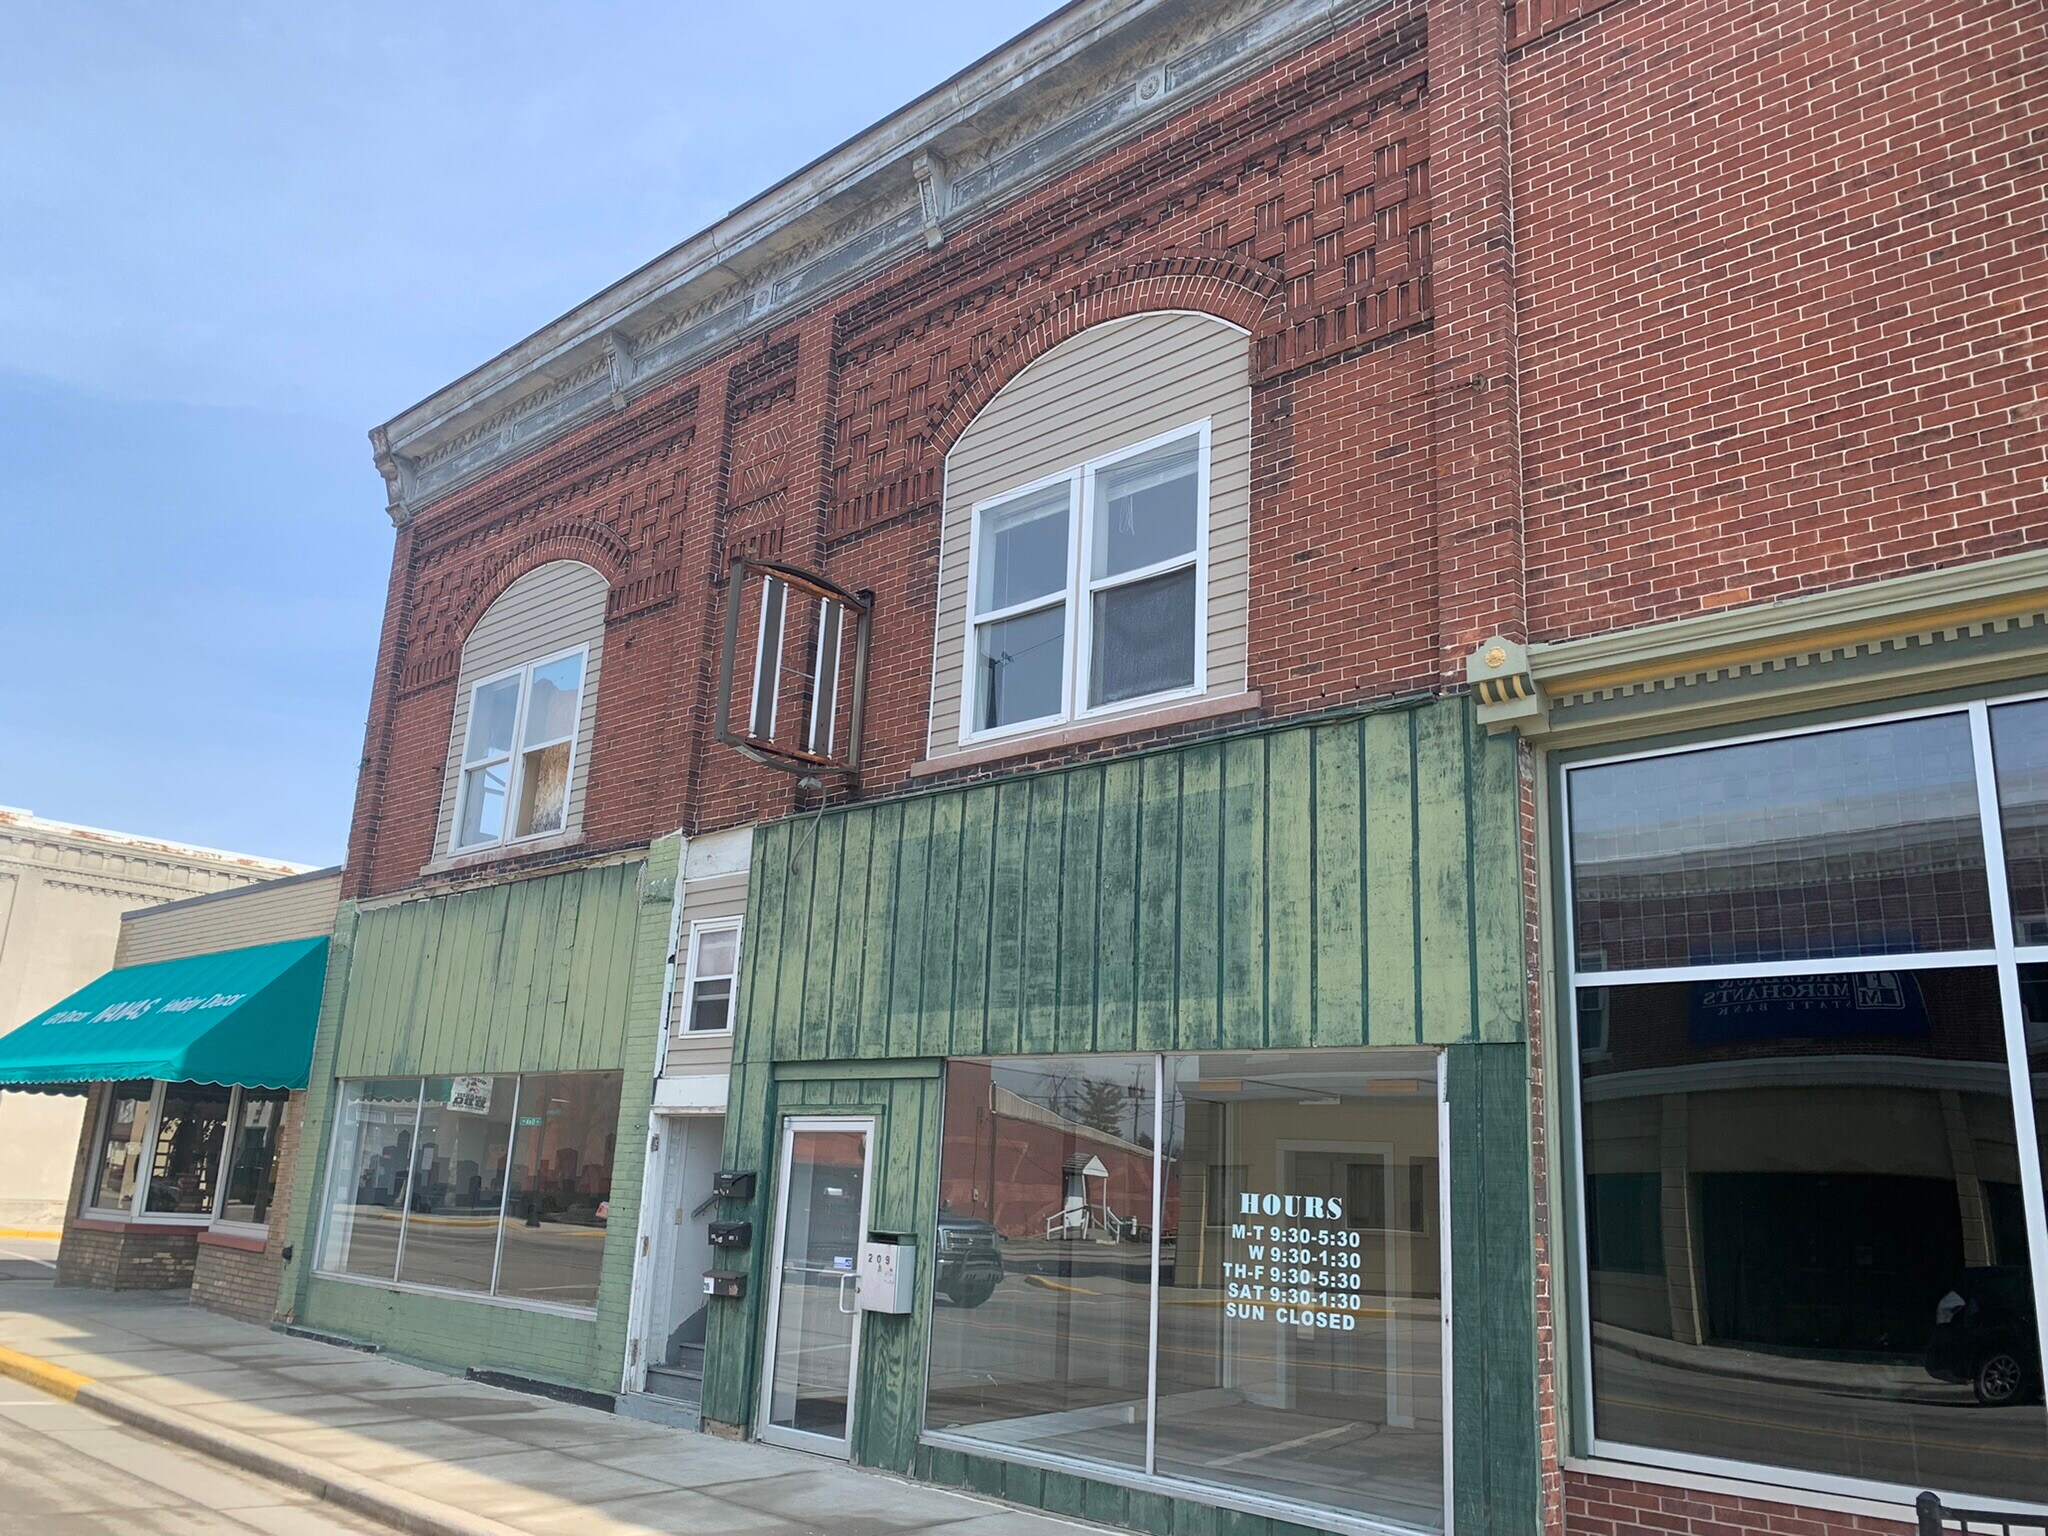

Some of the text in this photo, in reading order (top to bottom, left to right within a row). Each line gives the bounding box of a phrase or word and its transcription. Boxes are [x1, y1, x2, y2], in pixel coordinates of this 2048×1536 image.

[198, 993, 247, 1010] Decor
[1239, 1192, 1343, 1220] HOURS
[1232, 1224, 1361, 1248] M-T 9:30-5:30
[868, 1253, 891, 1265] 209
[1248, 1245, 1361, 1269] W 9:30-1:30
[1223, 1262, 1361, 1290] TH-F 9:30-5:30
[1228, 1282, 1361, 1310] SAT 9:30-1:30
[1226, 1302, 1356, 1331] SUN CLOSED
